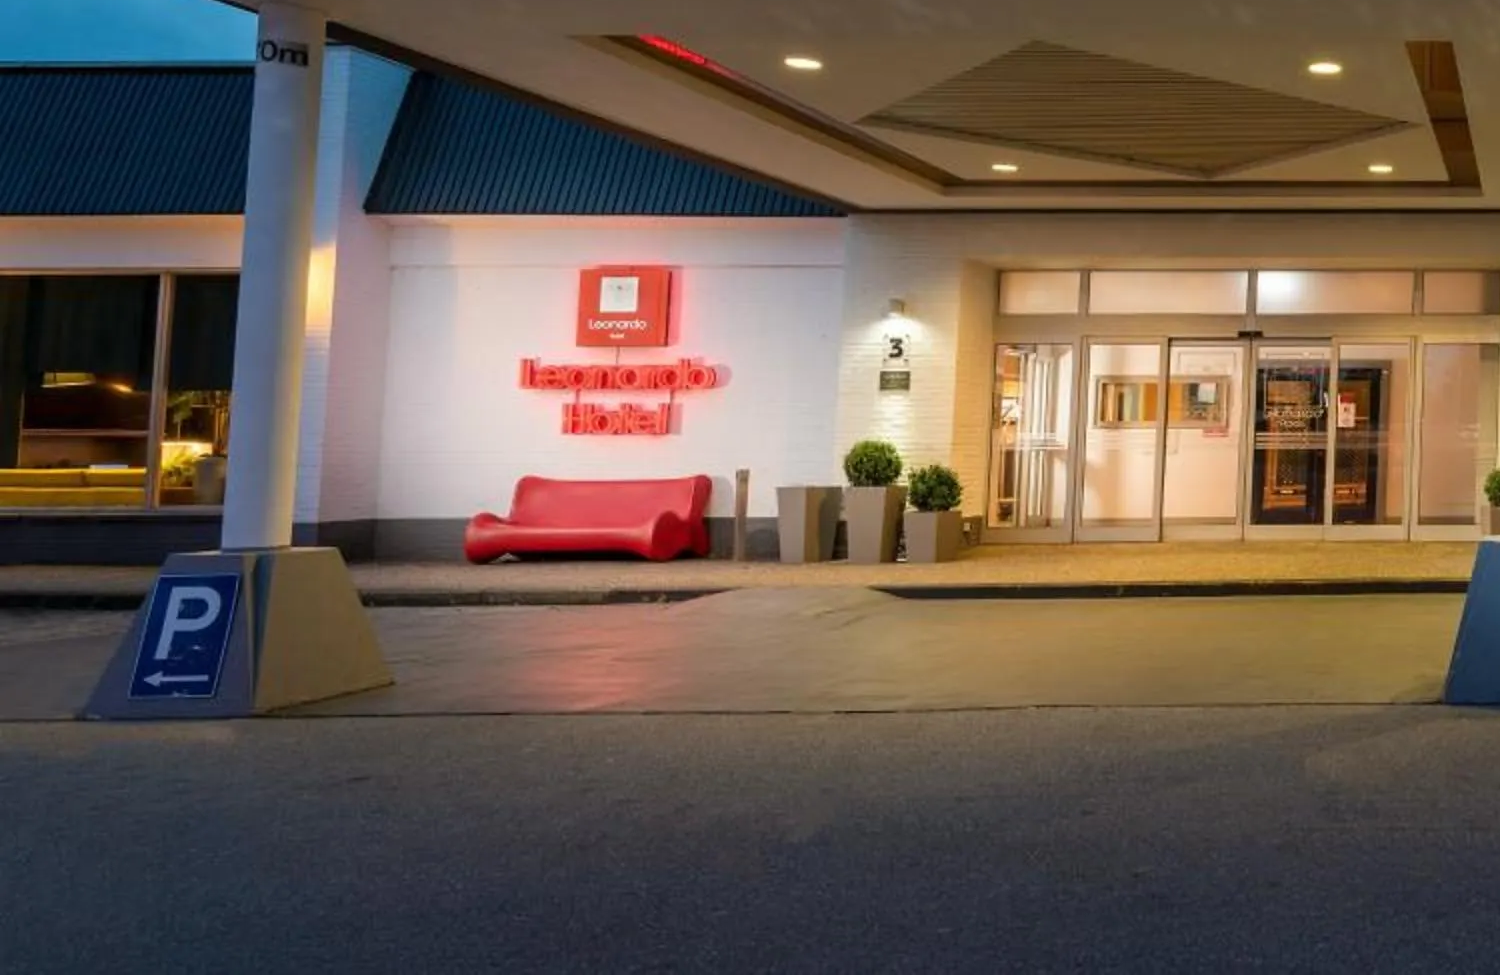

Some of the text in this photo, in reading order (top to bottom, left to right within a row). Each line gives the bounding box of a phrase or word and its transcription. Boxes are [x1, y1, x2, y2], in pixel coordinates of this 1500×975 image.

[888, 338, 903, 358] 3
[519, 358, 717, 390] Leonardo
[561, 403, 671, 435] Hotel
[153, 586, 222, 660] P
